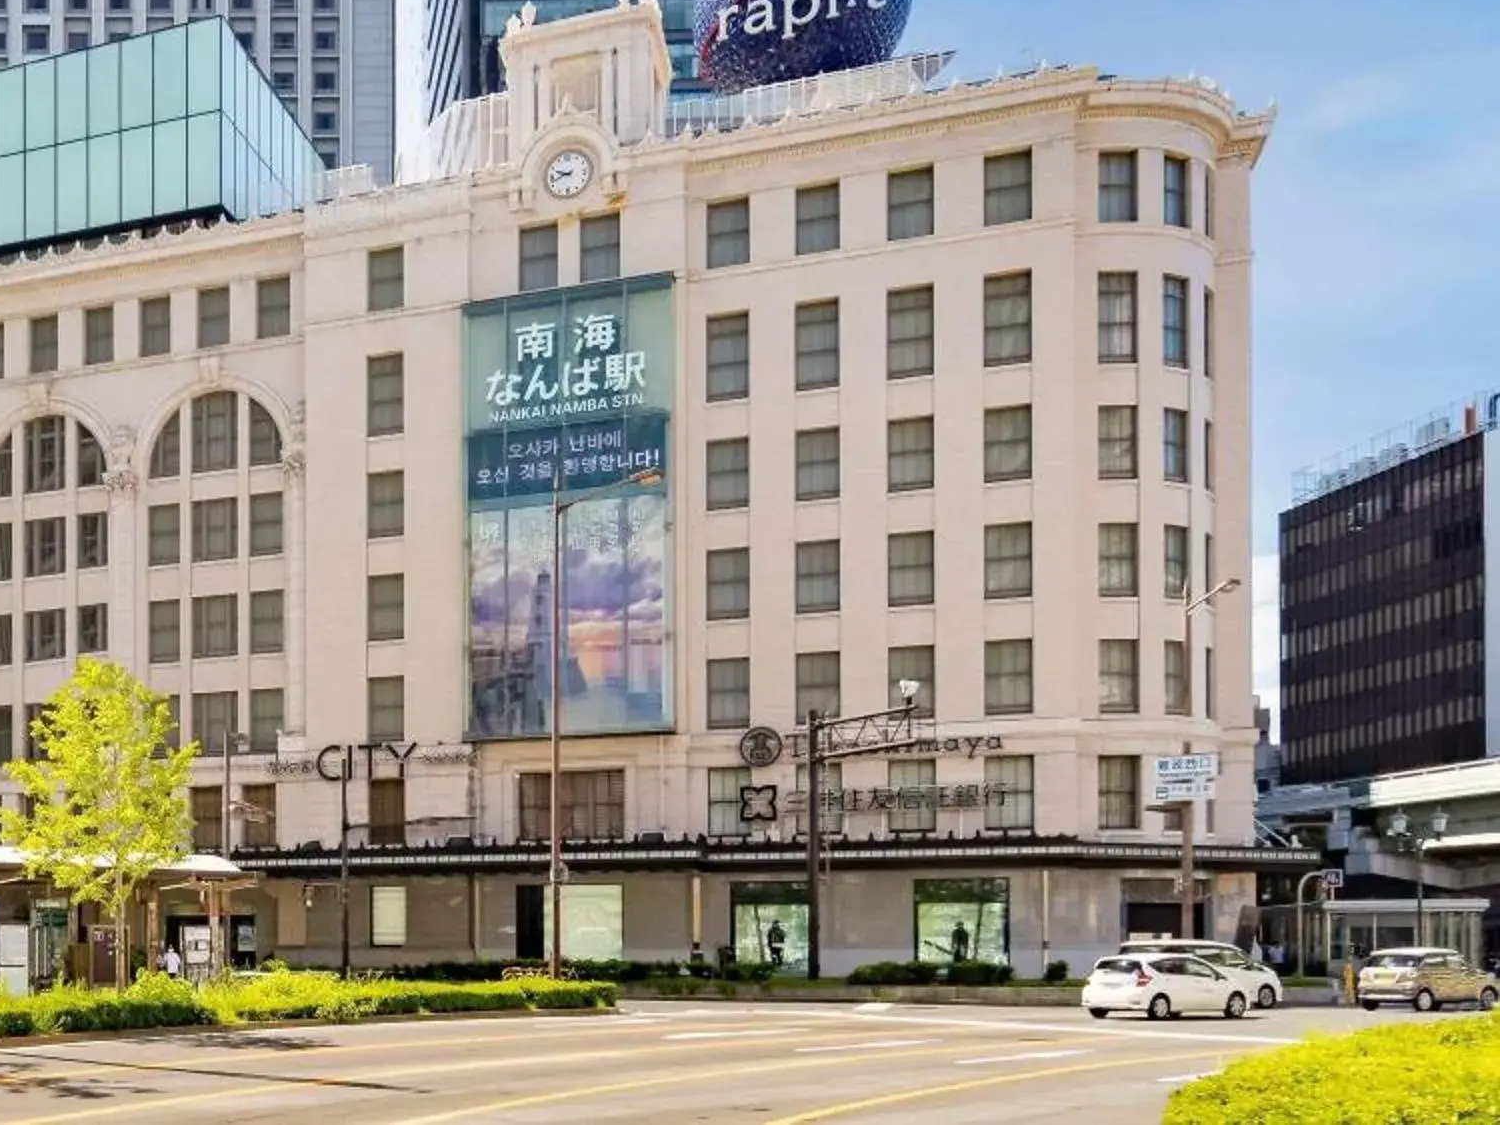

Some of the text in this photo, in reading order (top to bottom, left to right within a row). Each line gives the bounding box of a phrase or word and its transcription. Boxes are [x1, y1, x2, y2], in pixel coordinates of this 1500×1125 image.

[484, 351, 647, 407] なんば駅
[488, 406, 547, 423] NANKAI
[549, 397, 609, 416] NAMBA
[316, 742, 417, 781] CITY
